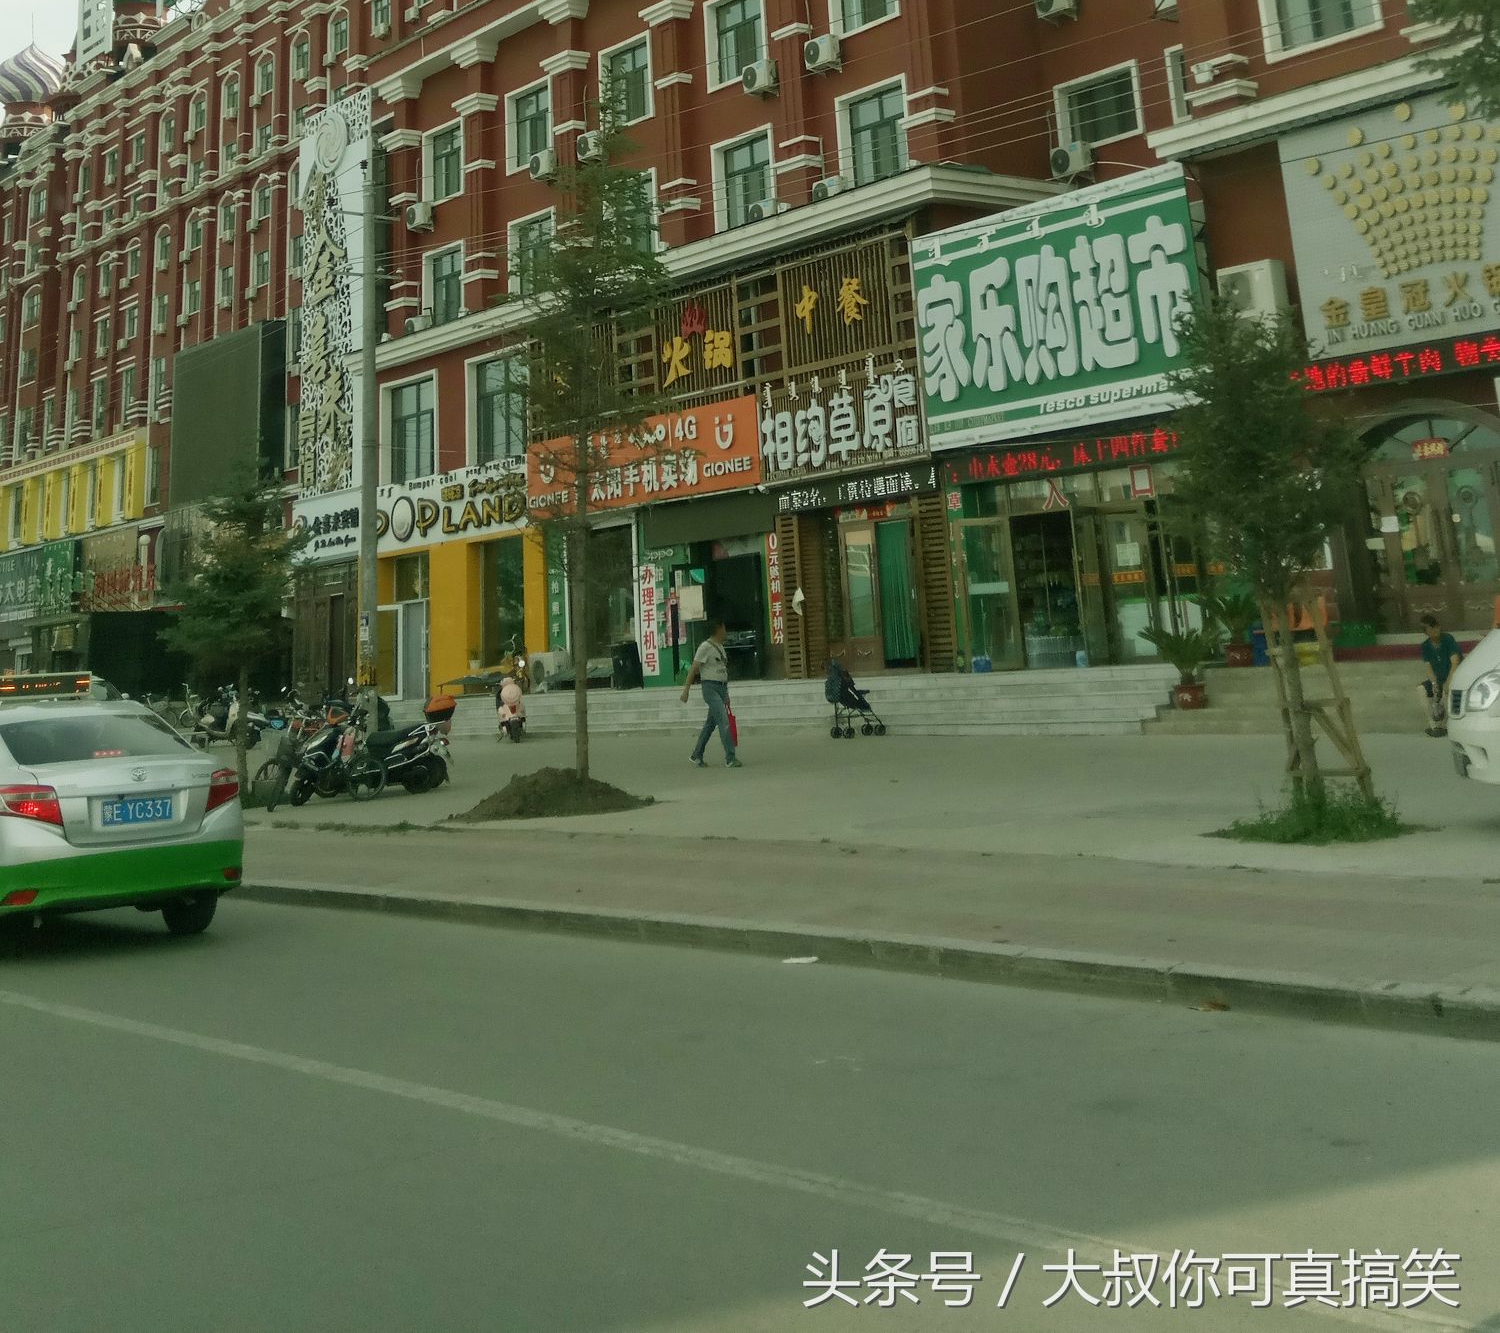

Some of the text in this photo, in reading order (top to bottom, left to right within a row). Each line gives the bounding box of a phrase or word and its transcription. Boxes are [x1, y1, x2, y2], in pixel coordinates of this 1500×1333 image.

[796, 278, 868, 334] 中餐
[918, 215, 1194, 402] 家乐购超市
[1351, 319, 1398, 339] HUANG
[1407, 311, 1445, 329] GUAN
[1453, 302, 1482, 321] HUO
[662, 330, 732, 388] 火锅
[675, 415, 697, 440] 4G
[762, 375, 893, 472] 相约草原
[1039, 394, 1086, 414] Tesco
[703, 456, 752, 478] GIONEE
[1042, 465, 1154, 510] 入口
[641, 566, 658, 672] 办理手机号
